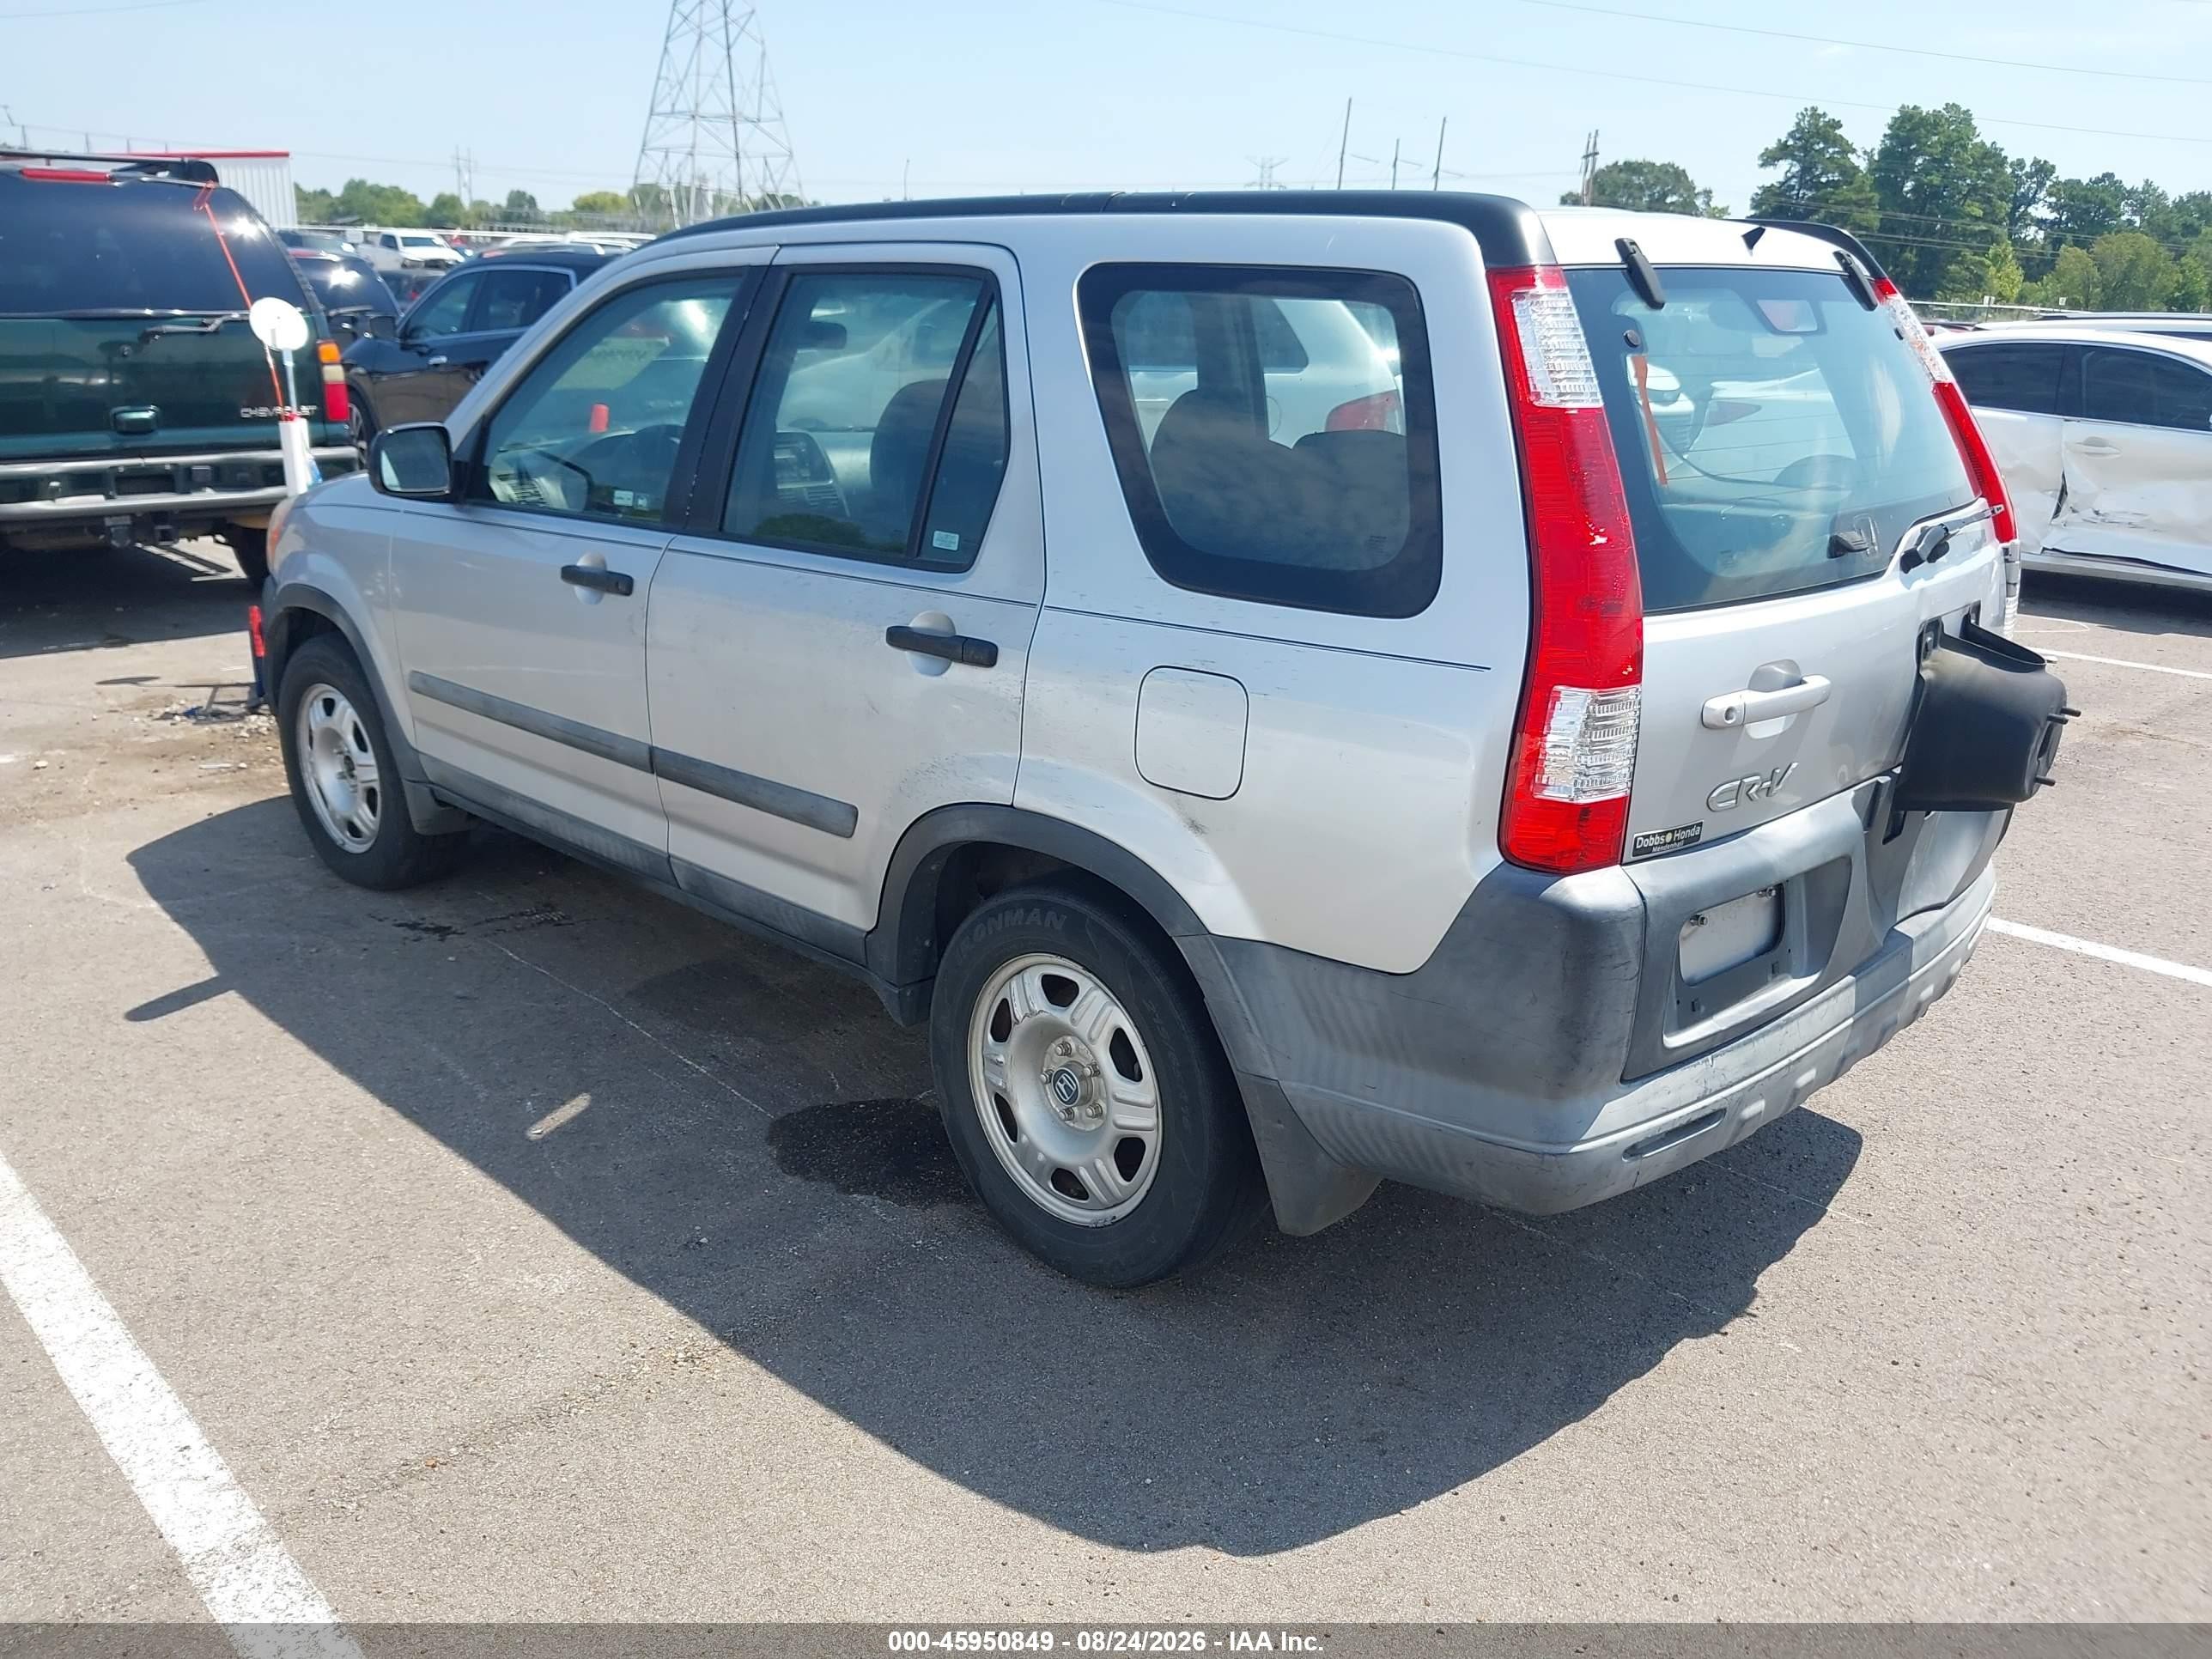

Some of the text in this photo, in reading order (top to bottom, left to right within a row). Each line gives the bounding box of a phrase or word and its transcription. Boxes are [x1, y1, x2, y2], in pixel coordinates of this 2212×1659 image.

[1706, 762, 1799, 811] CR-V
[1636, 825, 1701, 848] Dobbs Honda
